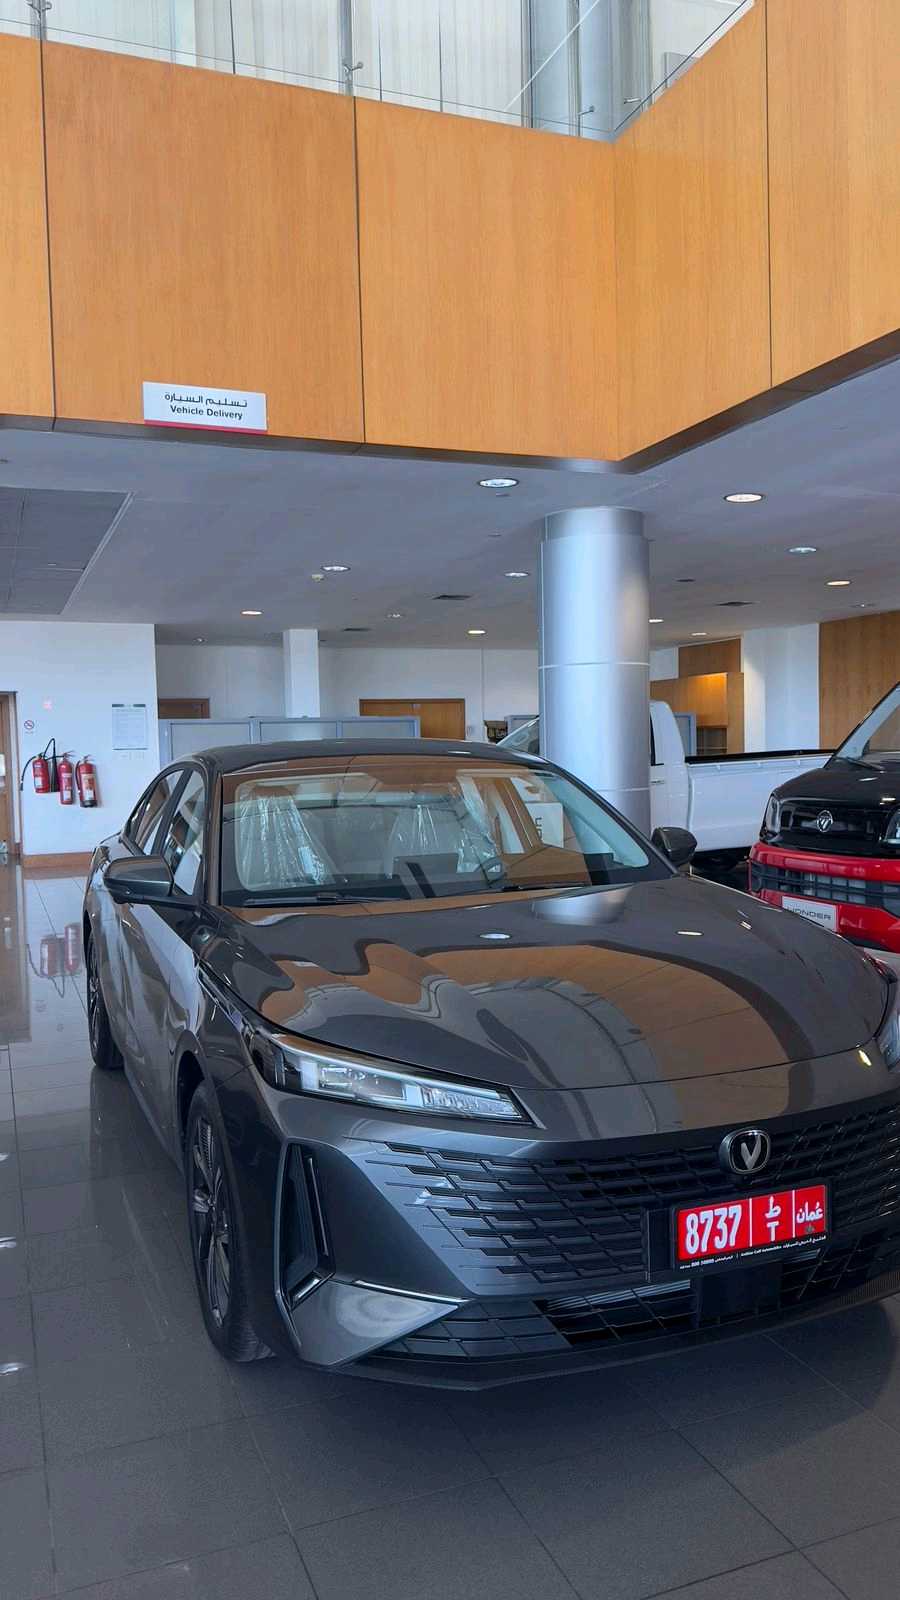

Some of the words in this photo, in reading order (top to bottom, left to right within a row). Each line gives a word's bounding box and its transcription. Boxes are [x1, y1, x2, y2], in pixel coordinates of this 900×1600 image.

[164, 391, 204, 403] السيارة
[205, 397, 248, 408] تسليم
[170, 404, 204, 416] Vehicle
[206, 408, 243, 420] Delivery
[764, 1195, 782, 1219] ط
[685, 1204, 743, 1255] 8737
[766, 1221, 780, 1242] T
